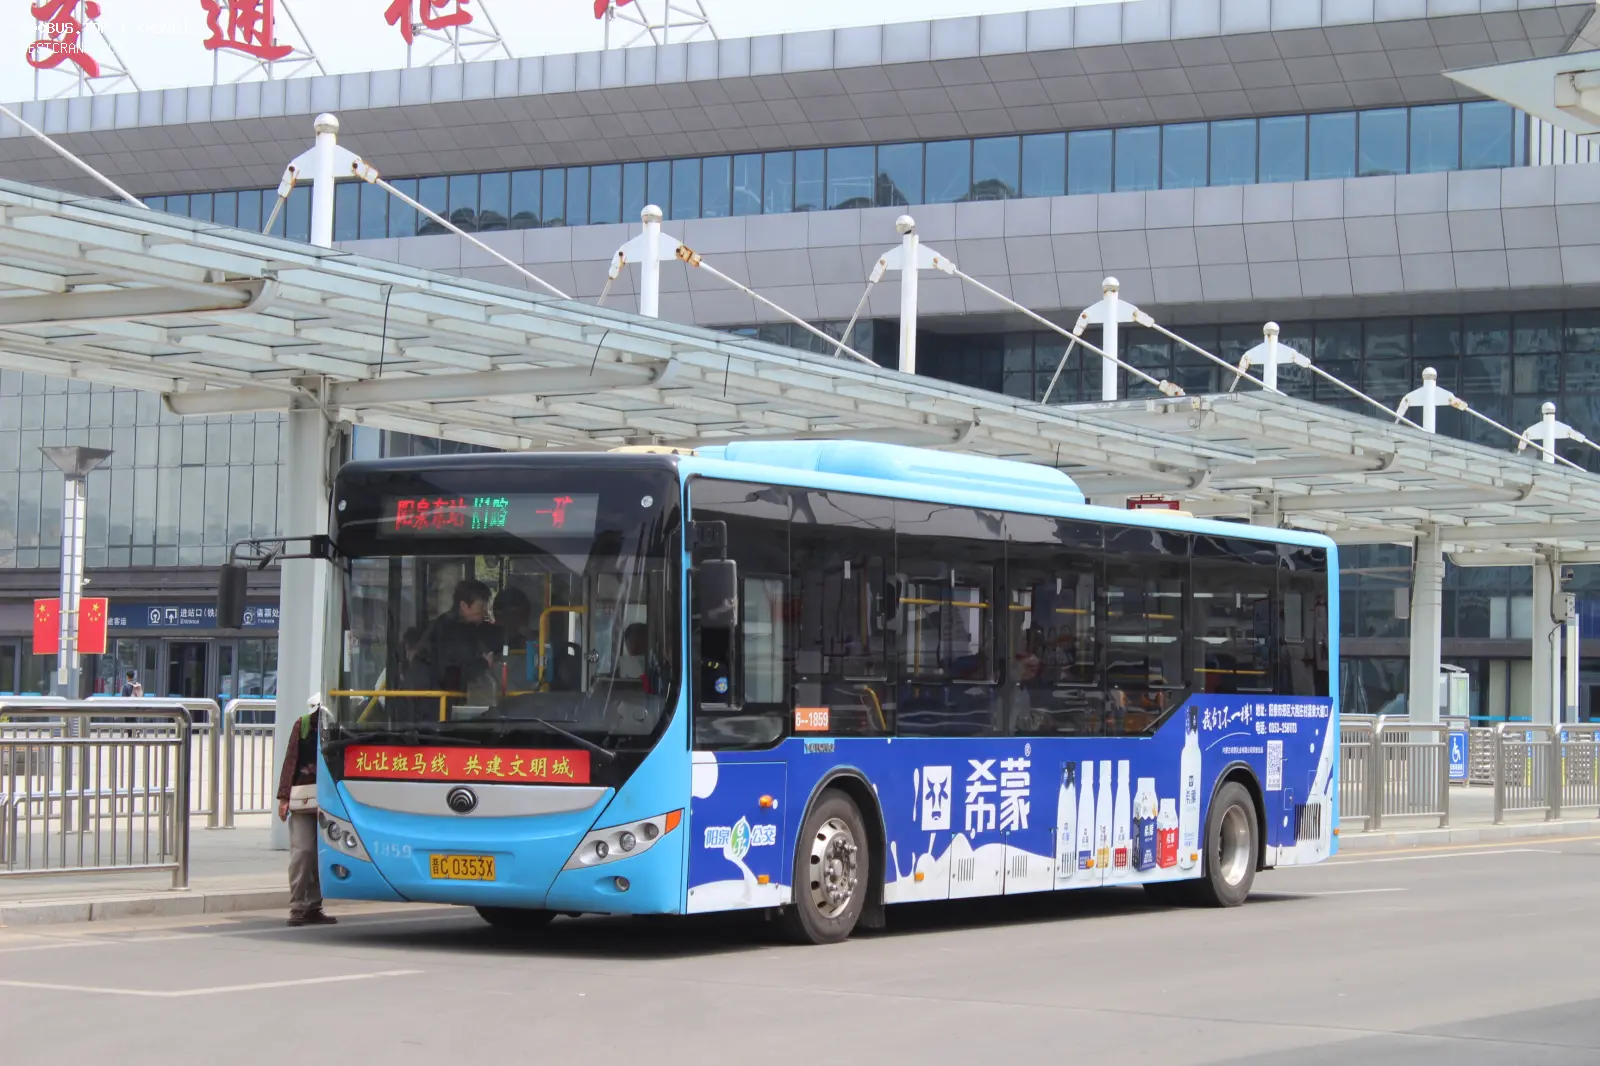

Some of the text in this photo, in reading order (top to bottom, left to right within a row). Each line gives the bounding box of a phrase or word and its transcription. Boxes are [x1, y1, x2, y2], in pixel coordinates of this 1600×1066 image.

[180, 608, 219, 618] 进站口（铁
[356, 752, 575, 778] 礼让斑马线 共建文明城
[964, 757, 1031, 833] 希蒙
